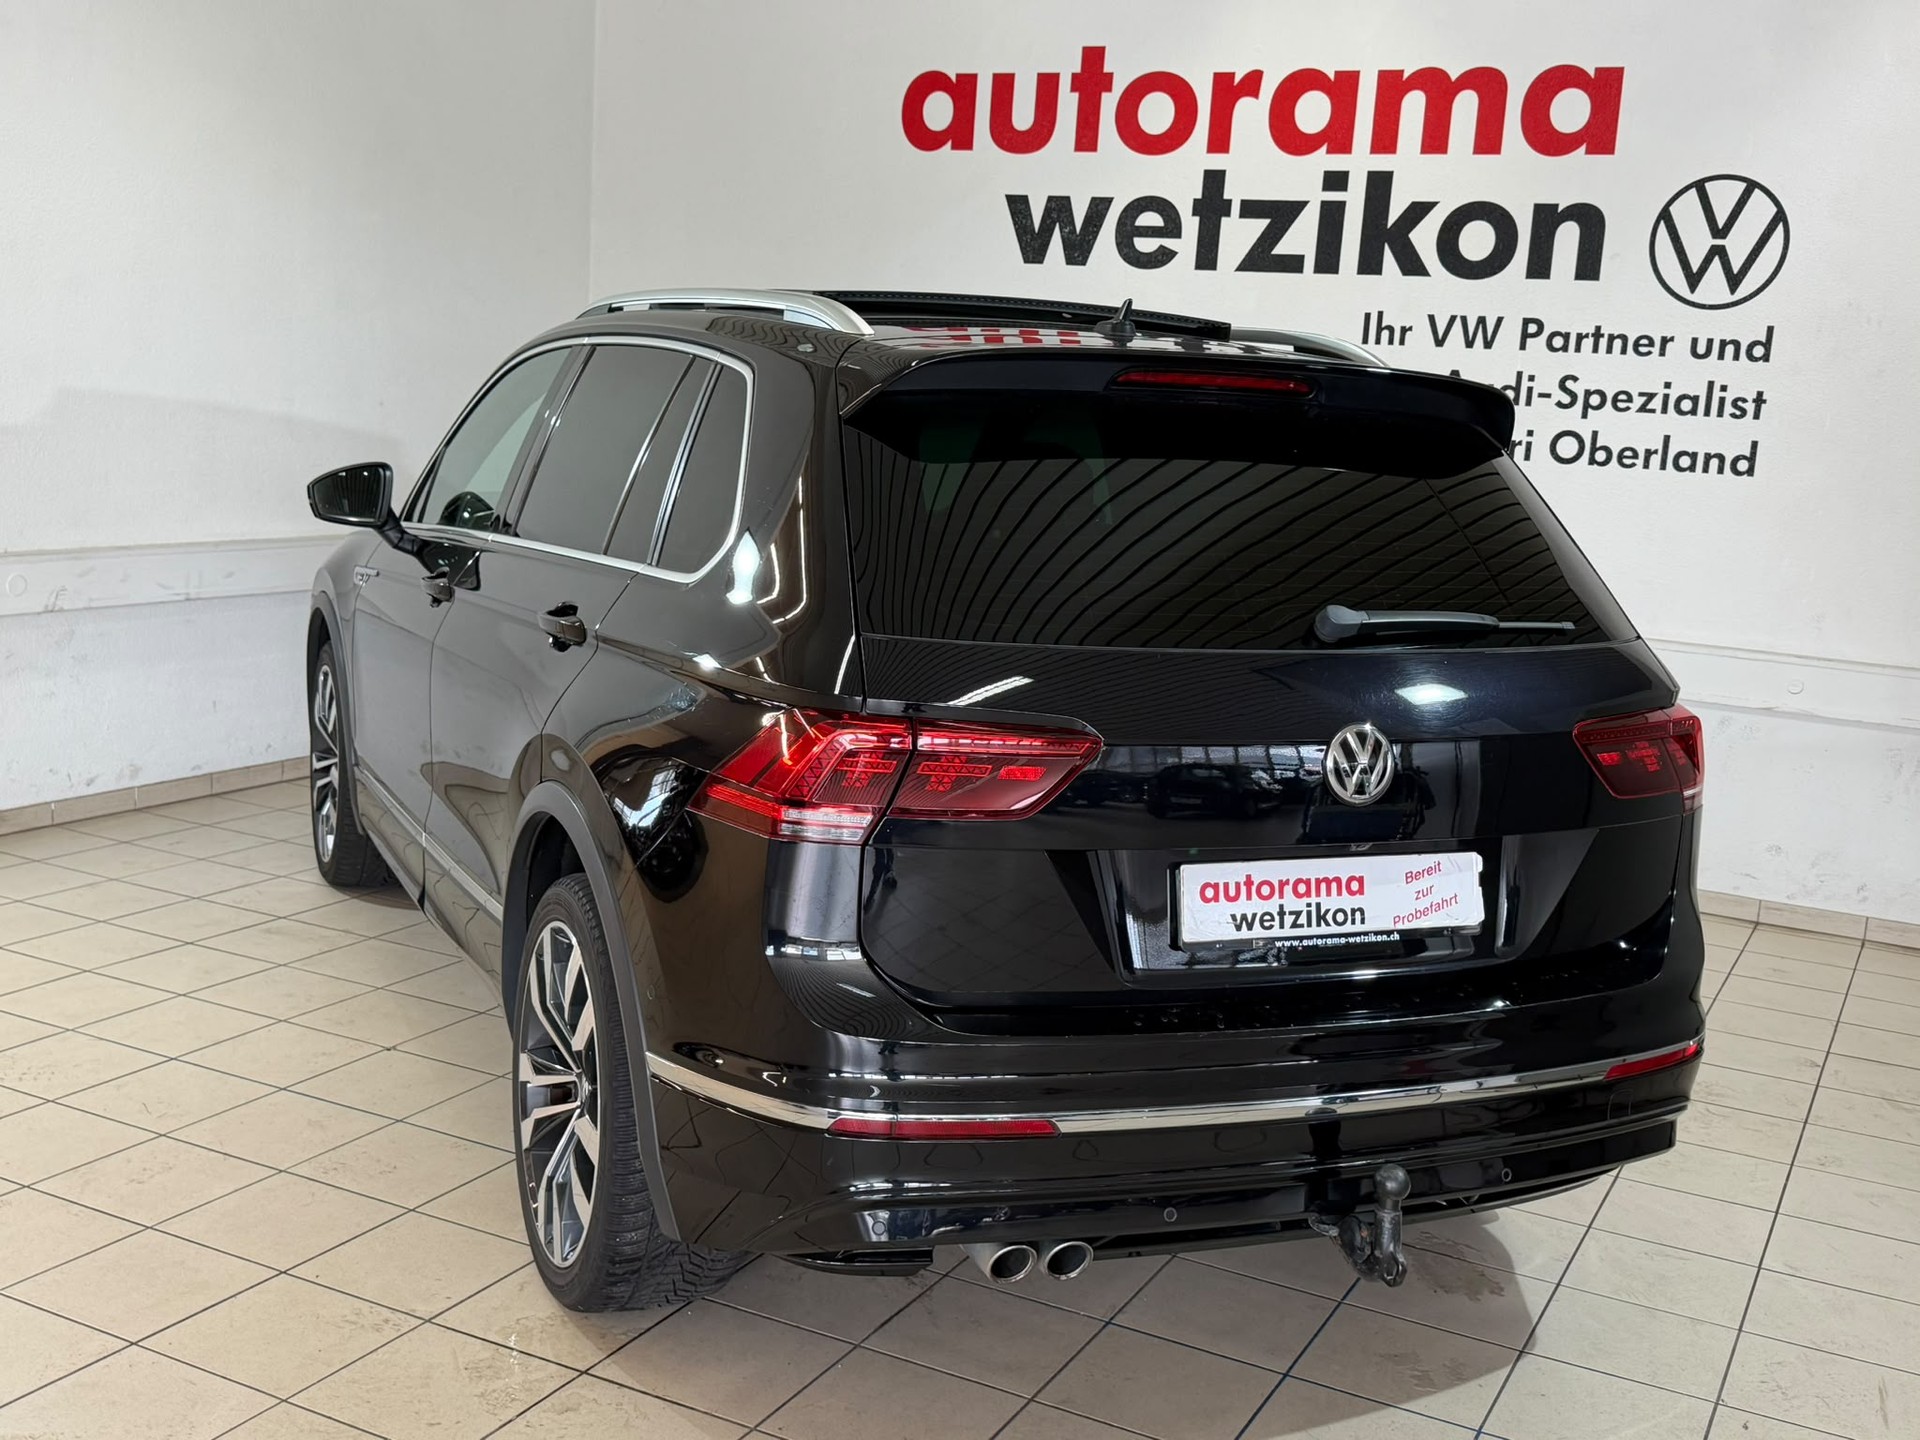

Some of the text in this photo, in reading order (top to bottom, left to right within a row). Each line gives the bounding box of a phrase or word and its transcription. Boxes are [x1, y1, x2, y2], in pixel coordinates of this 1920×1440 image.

[901, 46, 1624, 157] autorama
[1005, 170, 1605, 281] wetzikon
[1362, 311, 1775, 363] Ihr VW Partner und
[1449, 369, 1767, 421] di-Spezialist
[1549, 429, 1759, 477] Oberland
[1199, 873, 1366, 904] autorama
[1404, 860, 1442, 885] Bereit
[1414, 884, 1434, 901] zur
[1230, 902, 1366, 932] wetzikon
[1392, 893, 1459, 928] Probefahrt
[1274, 931, 1400, 948] www.autorama-wetzikon.ch
